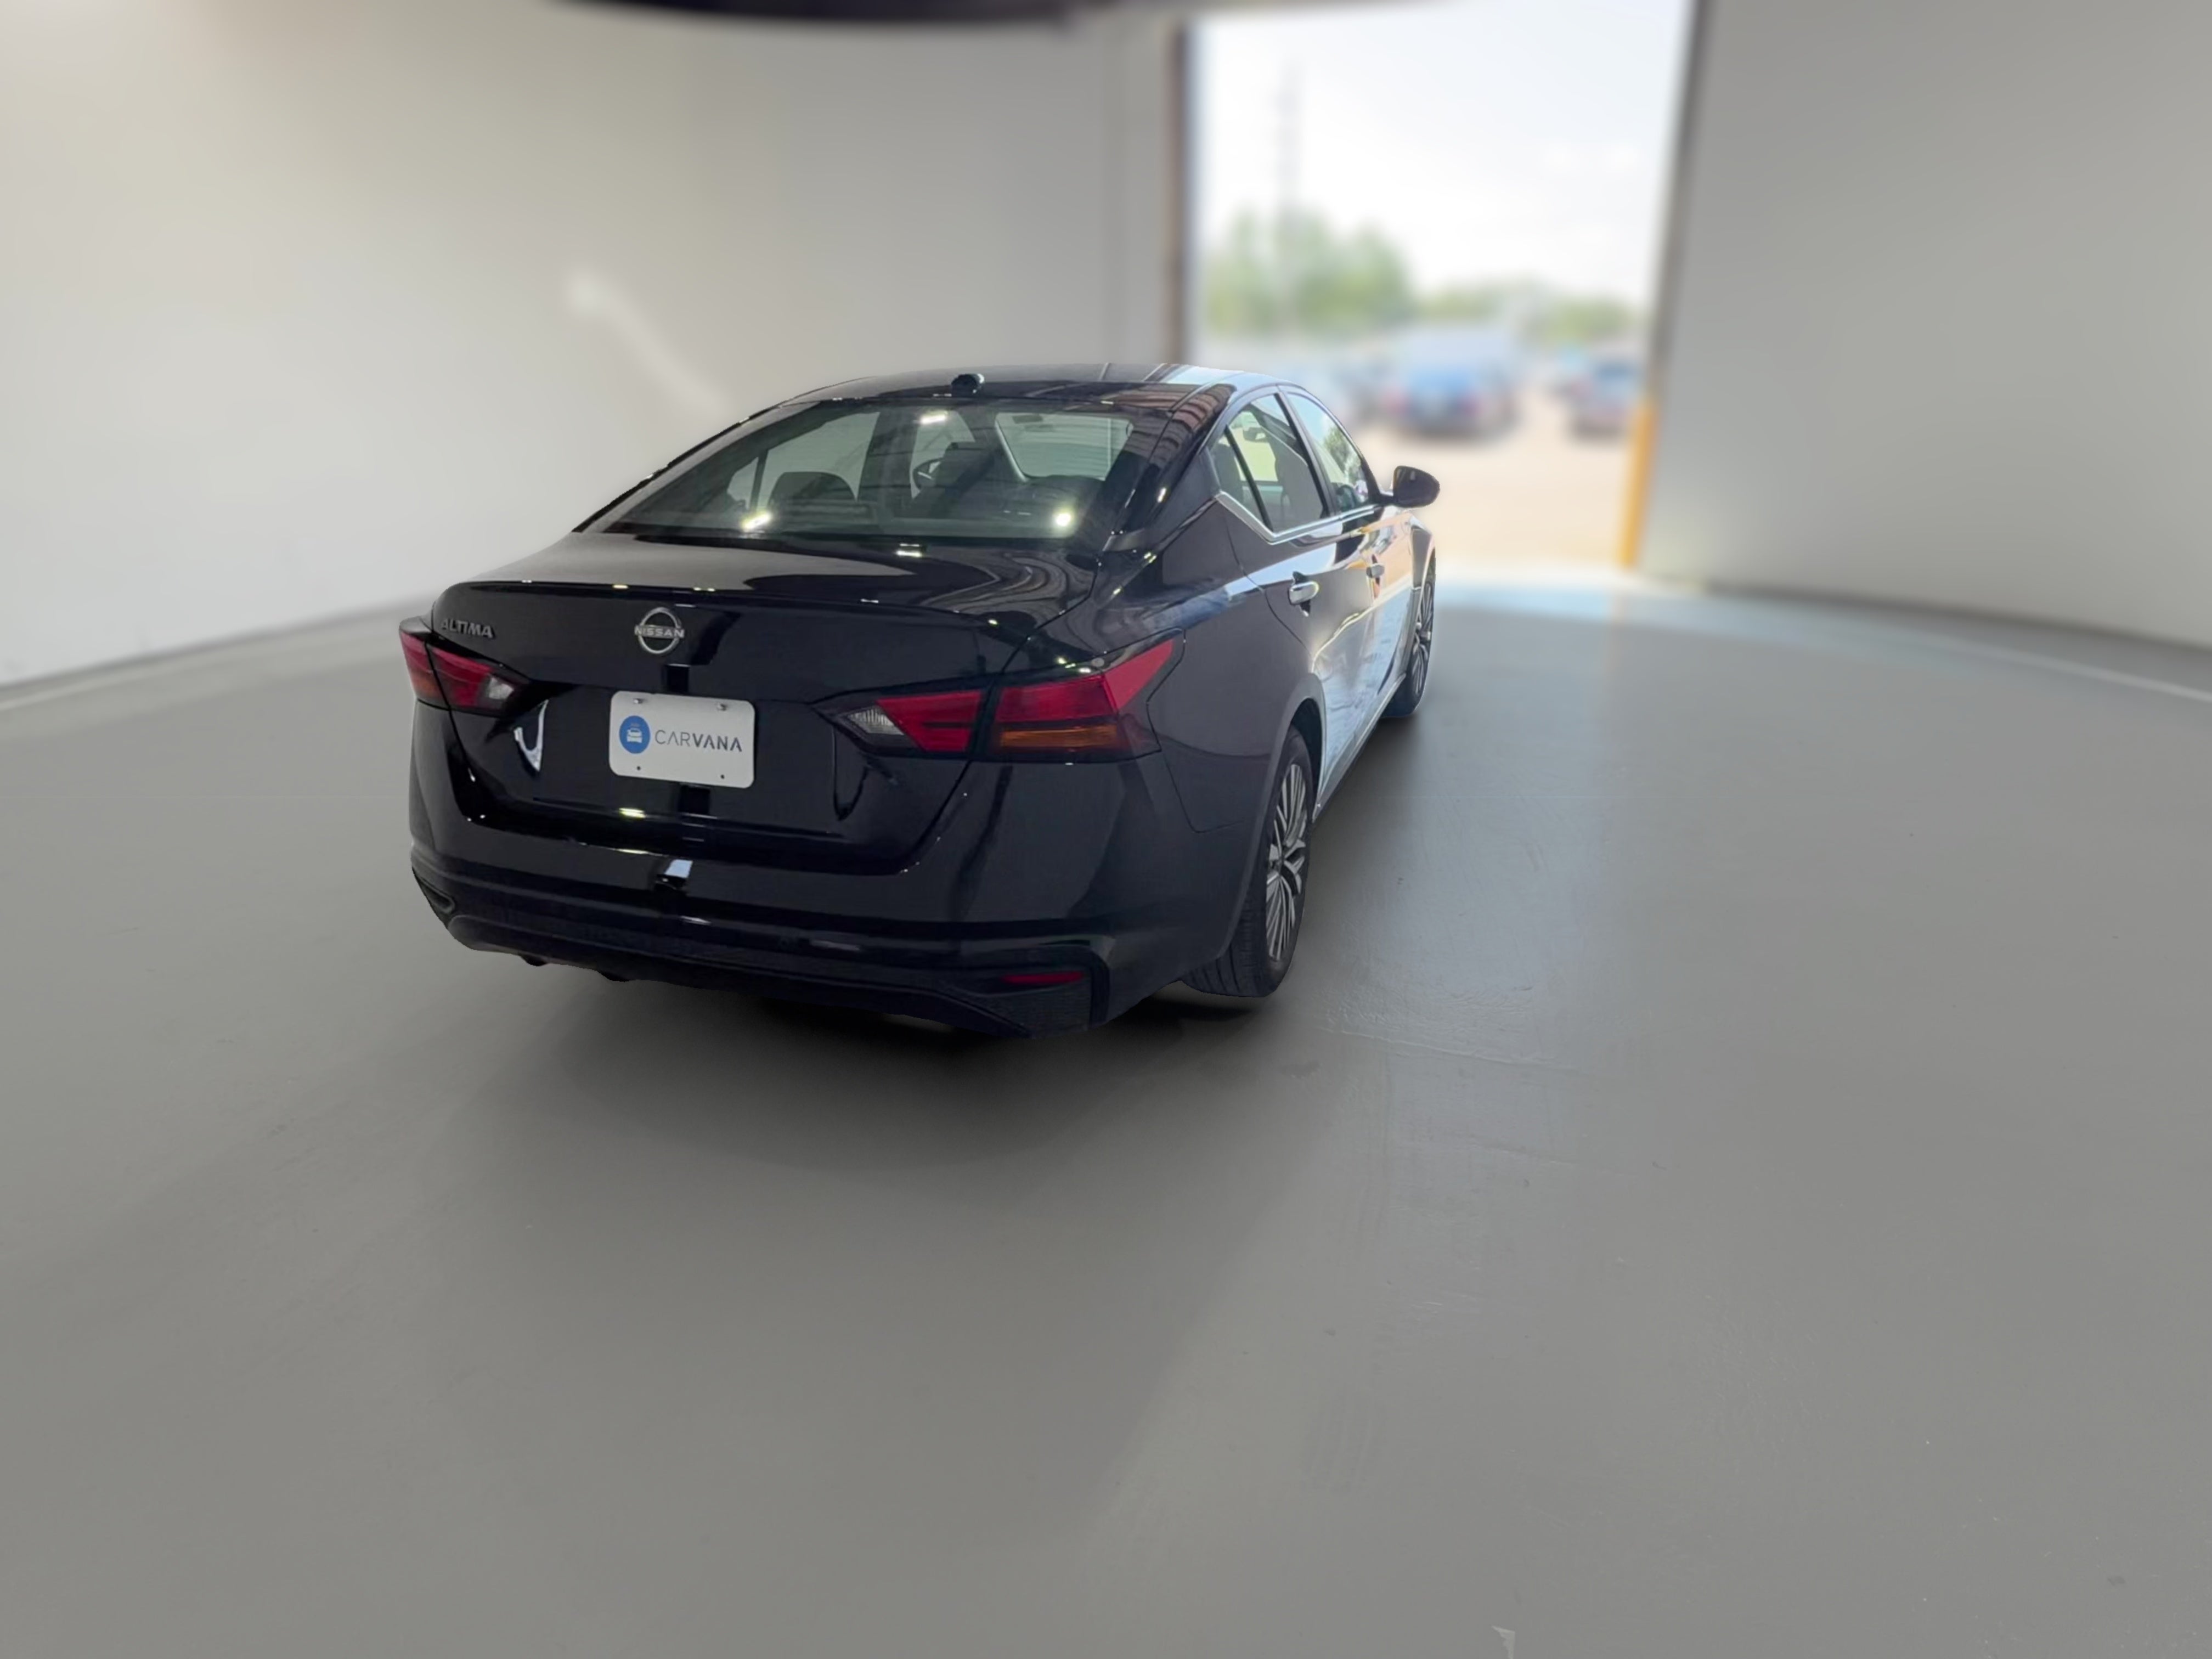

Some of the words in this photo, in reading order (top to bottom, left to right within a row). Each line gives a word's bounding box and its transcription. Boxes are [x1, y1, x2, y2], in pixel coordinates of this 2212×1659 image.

[441, 618, 493, 638] ALTIMA
[635, 625, 684, 638] NISSAN
[655, 730, 742, 752] CARVANA
